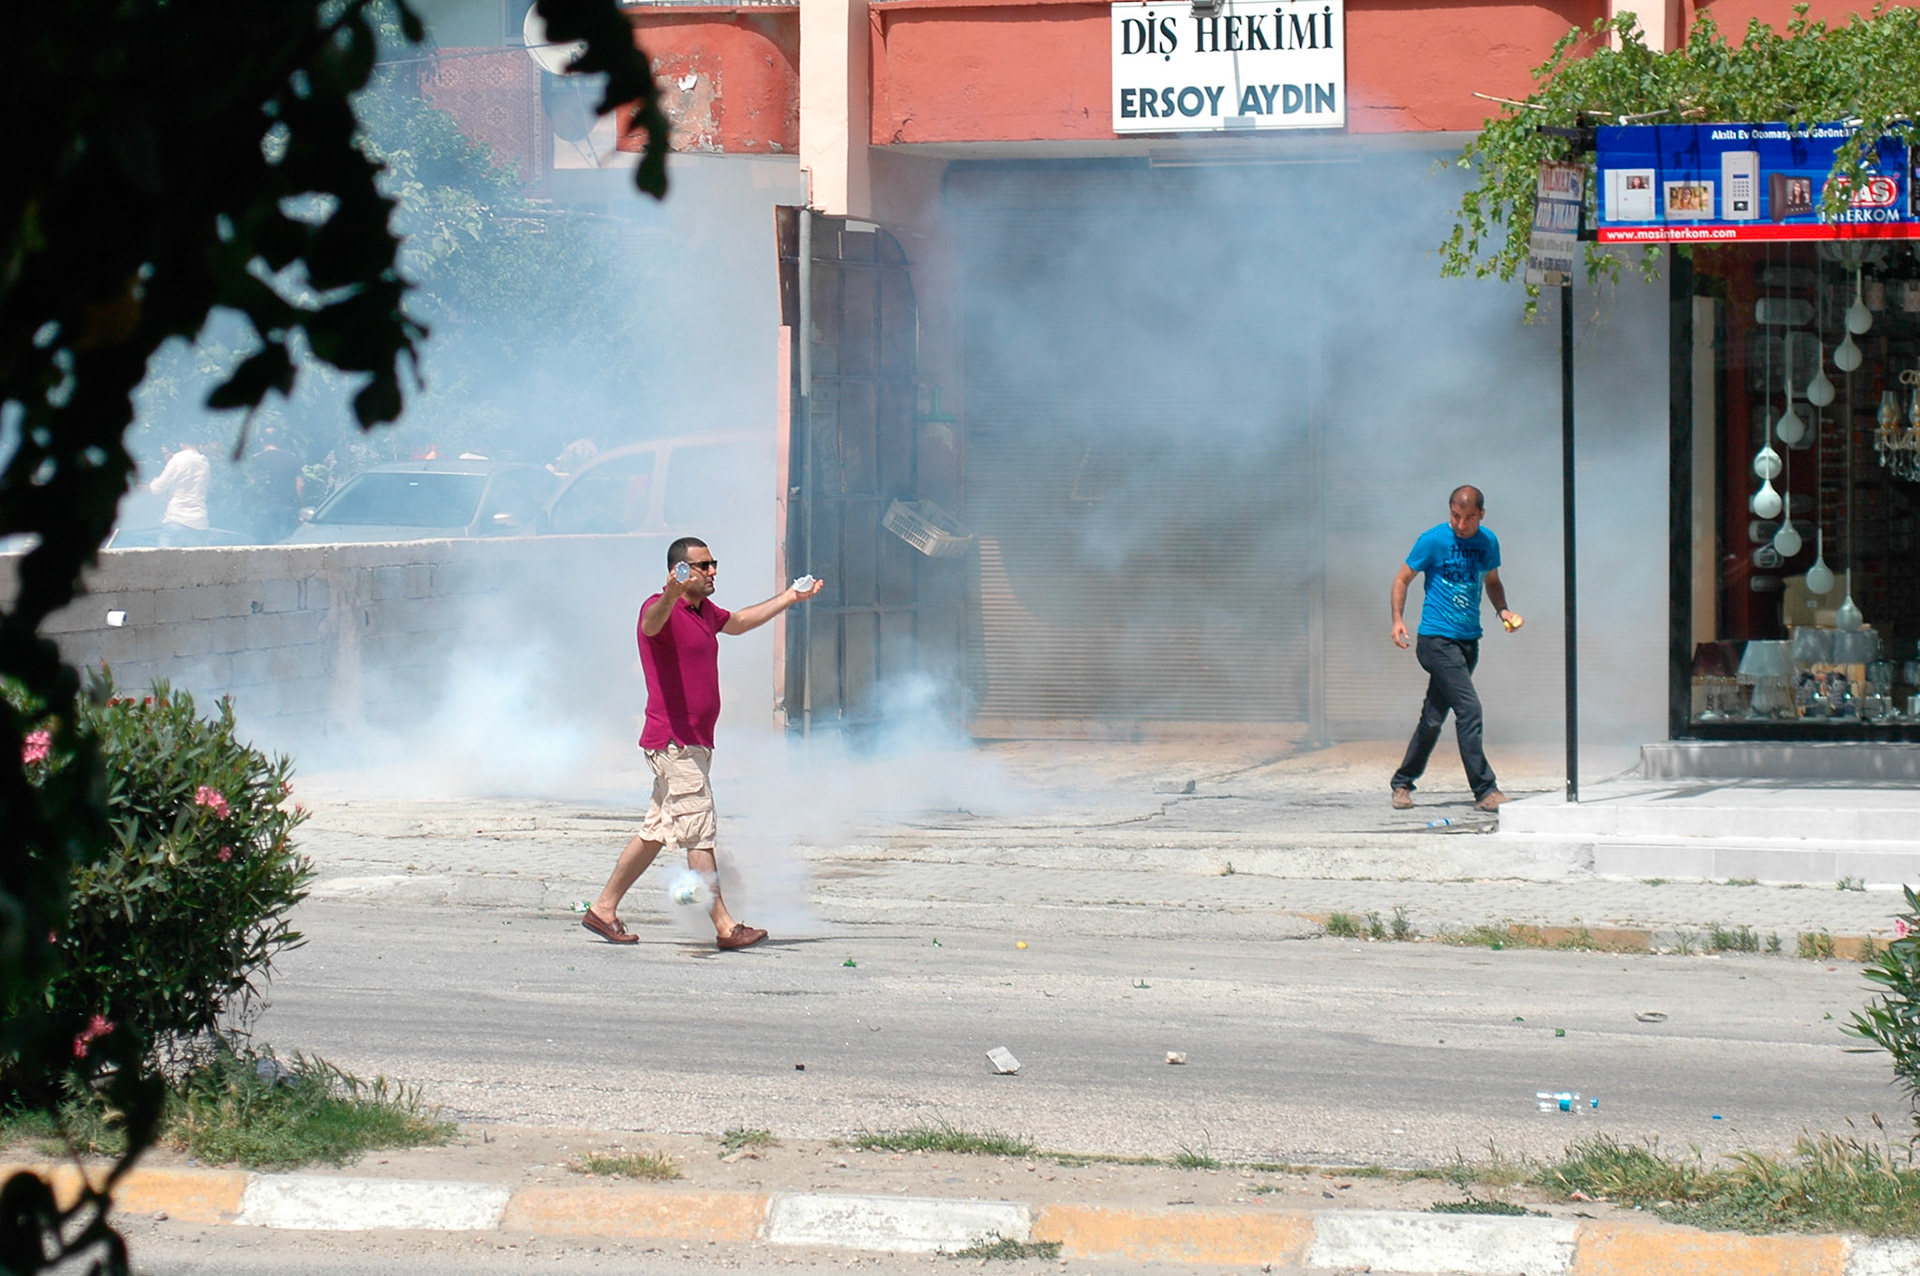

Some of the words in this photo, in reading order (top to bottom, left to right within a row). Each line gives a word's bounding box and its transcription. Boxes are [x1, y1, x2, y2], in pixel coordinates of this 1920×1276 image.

[1121, 11, 1178, 61] DİŞ
[1195, 7, 1334, 53] HEKİMİ
[1121, 86, 1225, 118] ERSOY
[1238, 82, 1336, 116] AYDIN
[1738, 129, 1750, 140] Ev
[1607, 228, 1737, 241] www.masinterkom.com
[1443, 570, 1477, 583] ROCK
